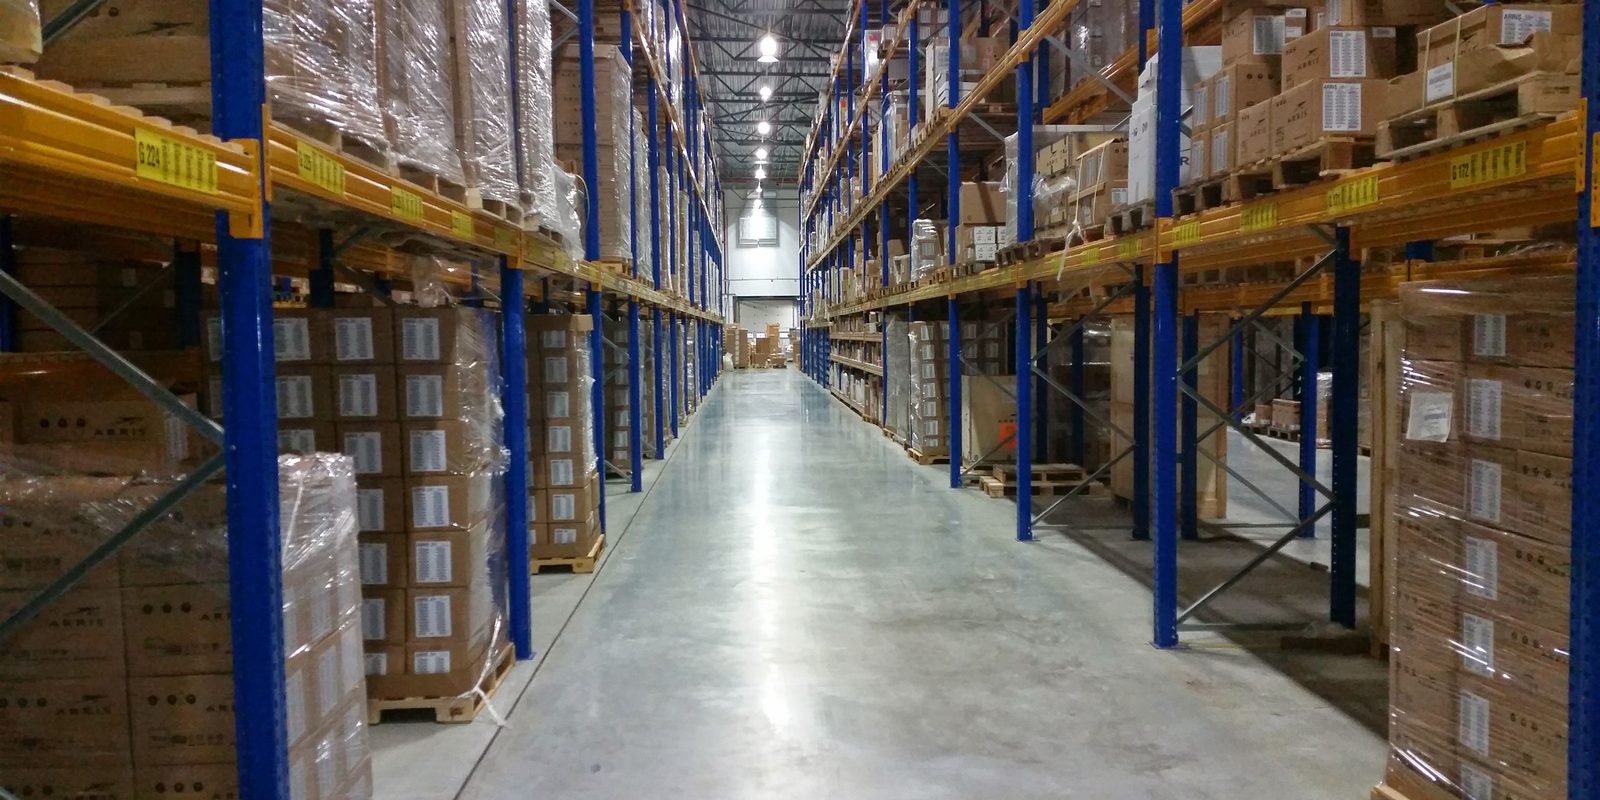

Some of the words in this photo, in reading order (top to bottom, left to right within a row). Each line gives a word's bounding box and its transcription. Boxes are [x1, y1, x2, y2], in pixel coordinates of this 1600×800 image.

[138, 141, 145, 165] G
[146, 143, 160, 169] 224
[1458, 162, 1470, 179] 172
[93, 427, 147, 437] ARRIS
[50, 618, 104, 628] ARRIS
[55, 706, 111, 716] ARRIS
